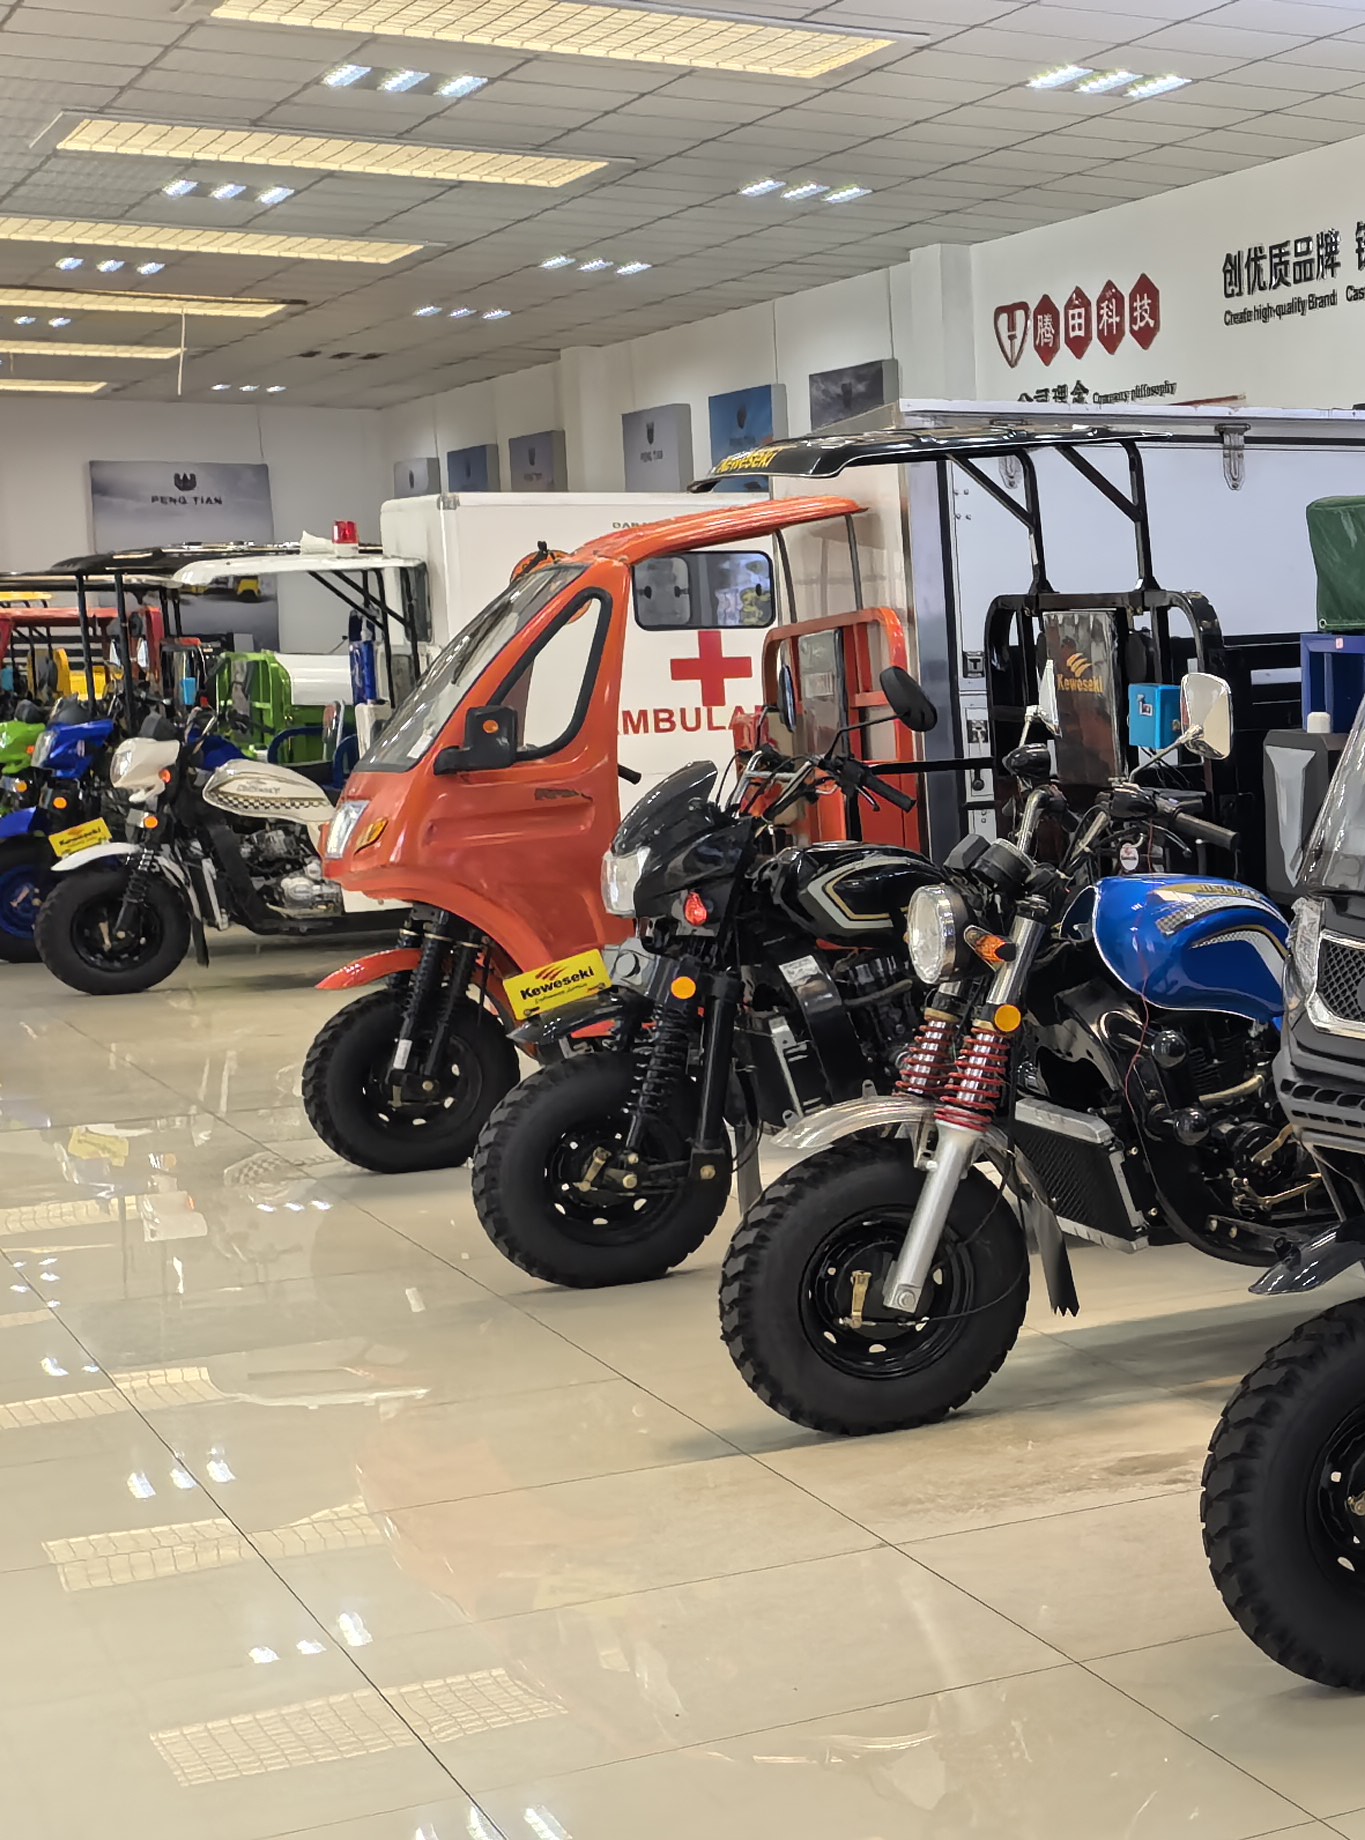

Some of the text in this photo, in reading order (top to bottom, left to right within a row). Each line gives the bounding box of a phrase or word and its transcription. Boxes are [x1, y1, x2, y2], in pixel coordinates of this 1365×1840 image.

[1222, 228, 1341, 299] 创优质品牌
[1035, 293, 1155, 347] 腾田科技
[1223, 307, 1253, 327] Create
[1253, 293, 1307, 323] high-quality
[1308, 289, 1338, 311] Brand
[150, 495, 223, 505] PENG TIAN
[616, 704, 765, 736] MBULA
[520, 965, 595, 1000] Keweseki
